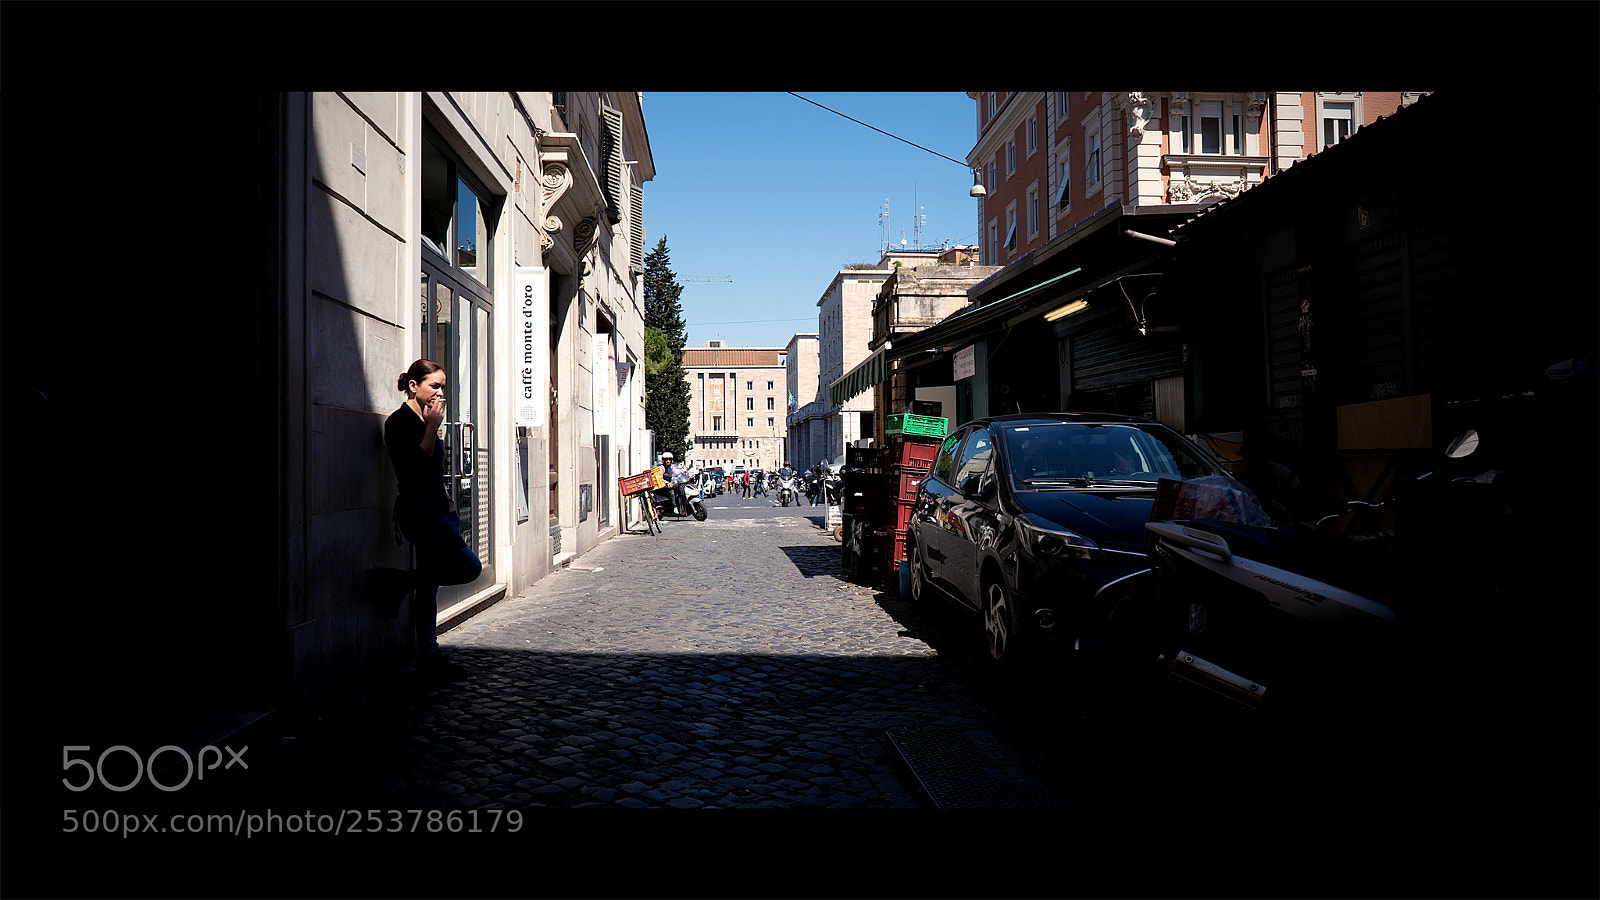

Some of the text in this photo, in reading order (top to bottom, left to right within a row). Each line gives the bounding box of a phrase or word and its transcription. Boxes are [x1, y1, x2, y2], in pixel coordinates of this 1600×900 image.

[521, 284, 533, 400] caffè monte d'oro
